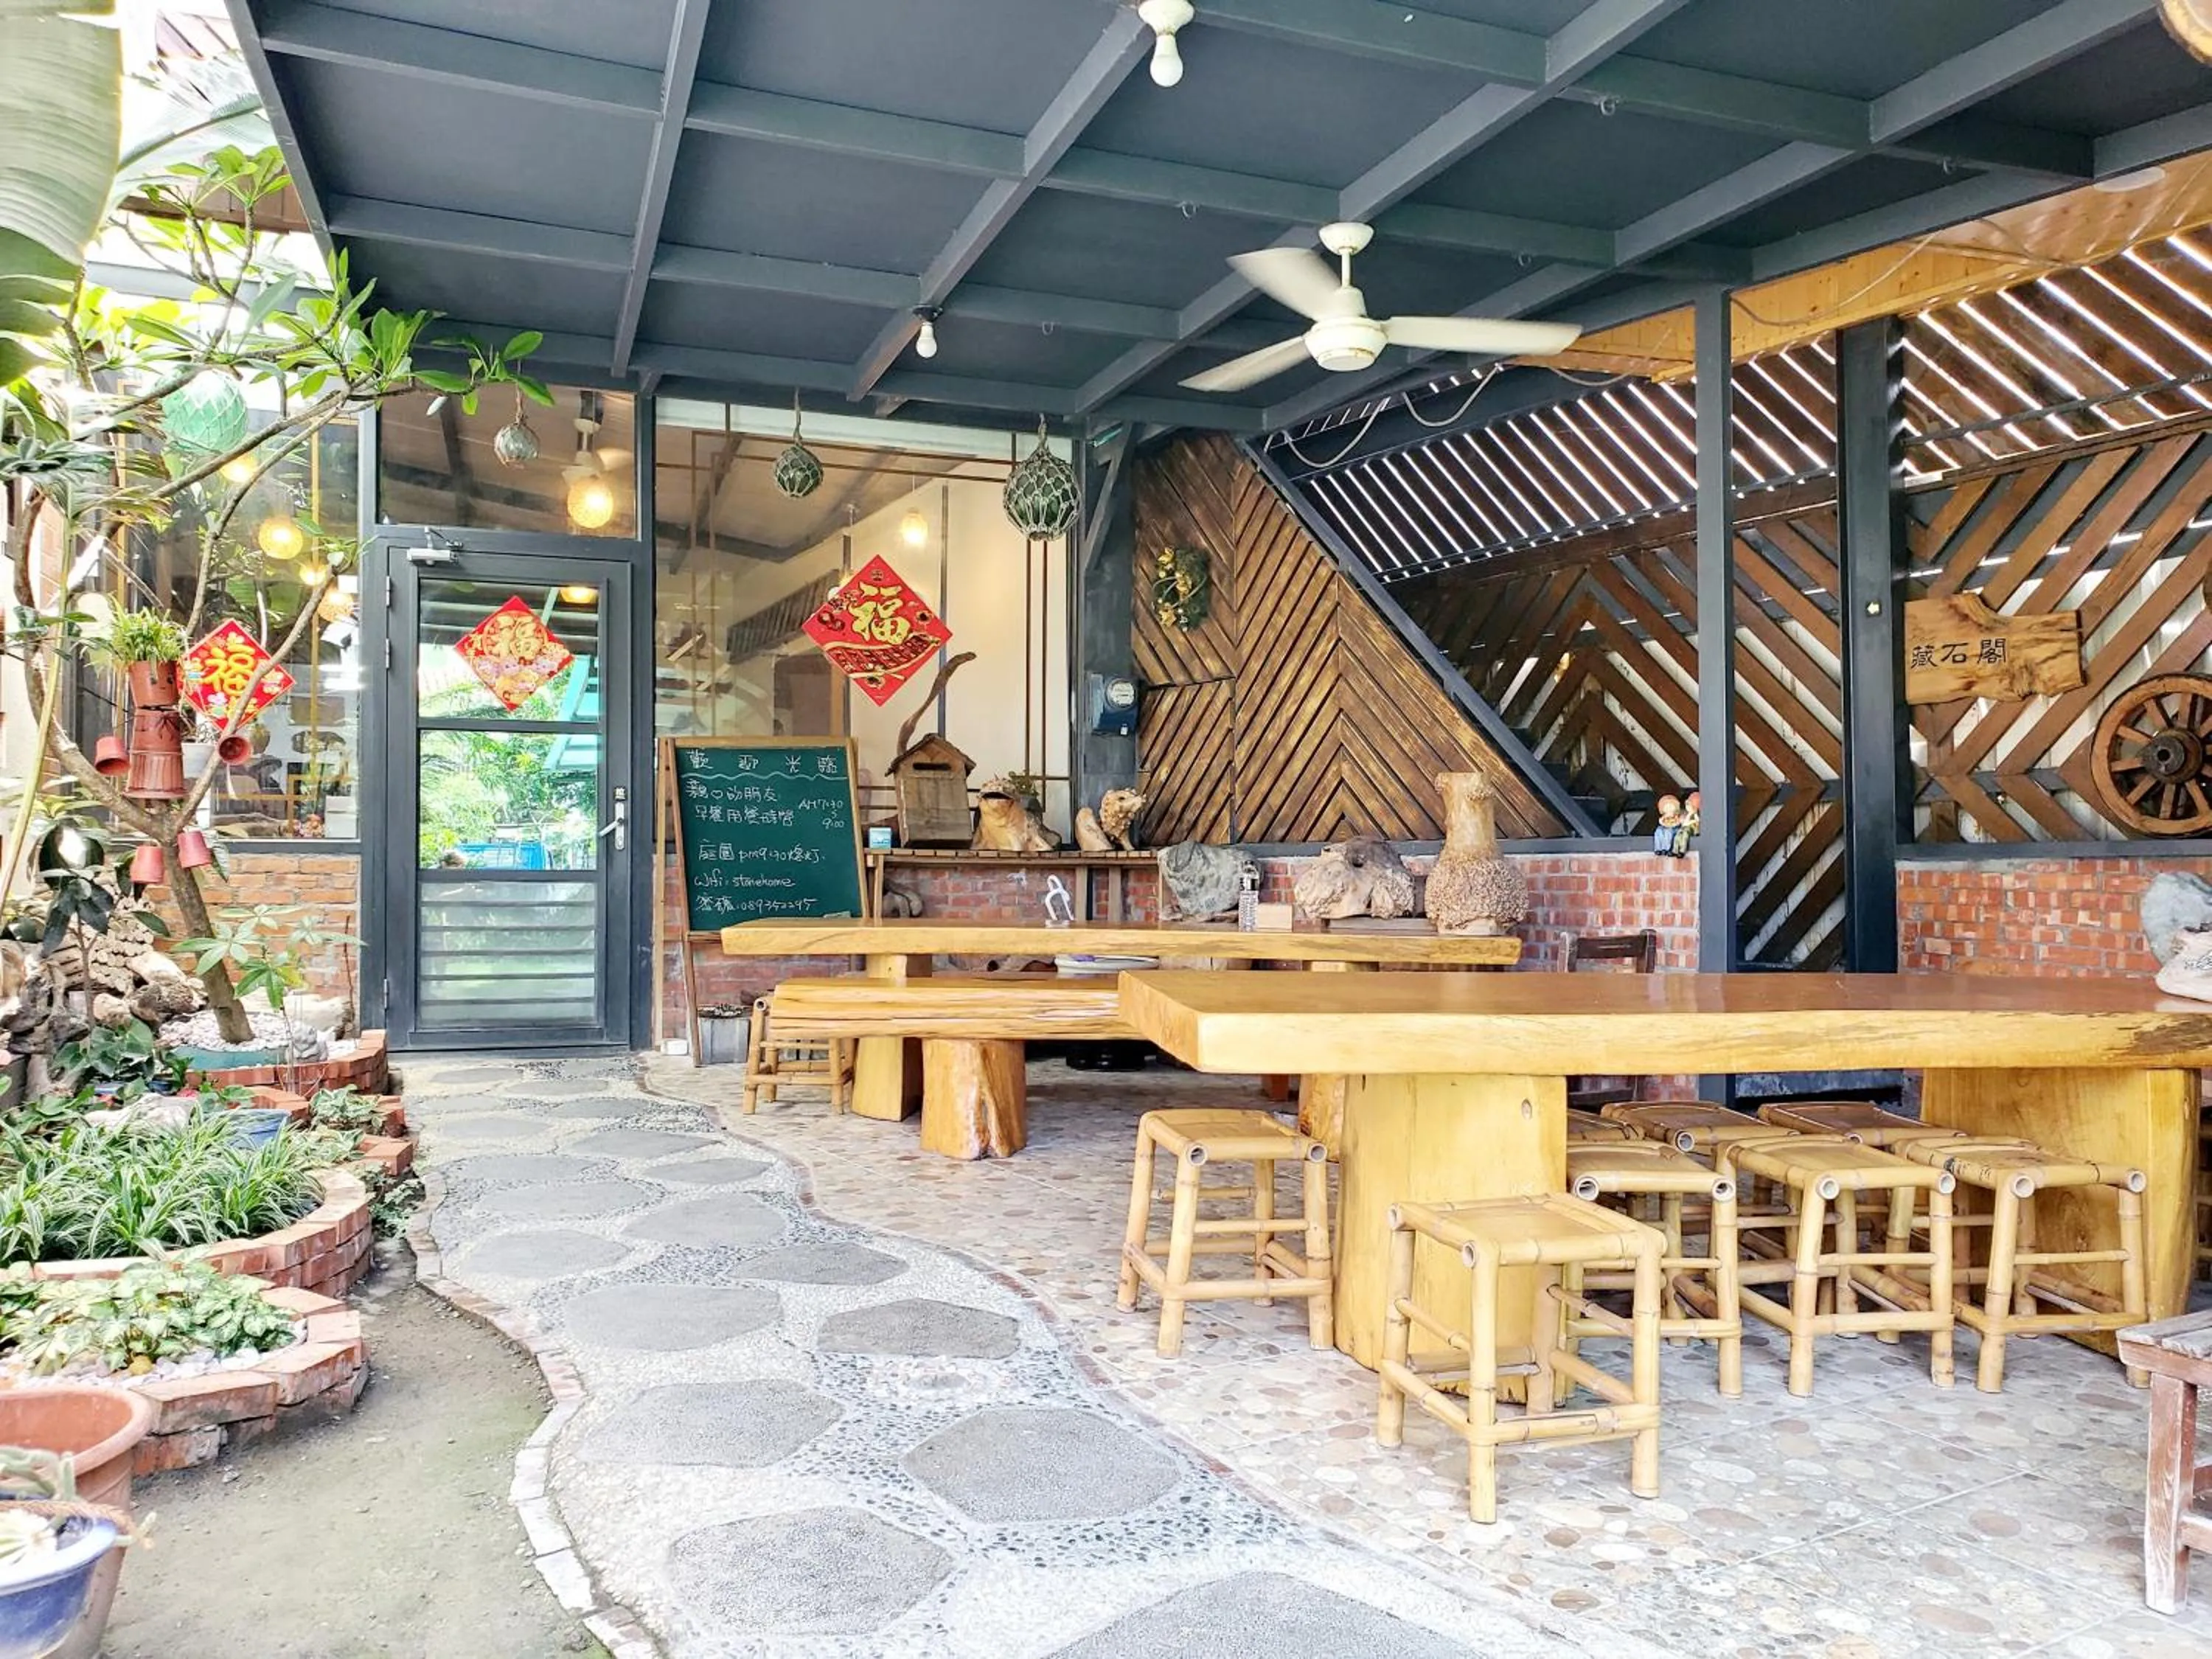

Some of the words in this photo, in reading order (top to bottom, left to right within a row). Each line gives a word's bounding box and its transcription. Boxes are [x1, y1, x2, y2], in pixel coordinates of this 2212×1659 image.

[849, 581, 911, 645] 福
[491, 615, 543, 661] 福
[1910, 638, 2007, 669] 藏石閣
[201, 644, 256, 696] 福
